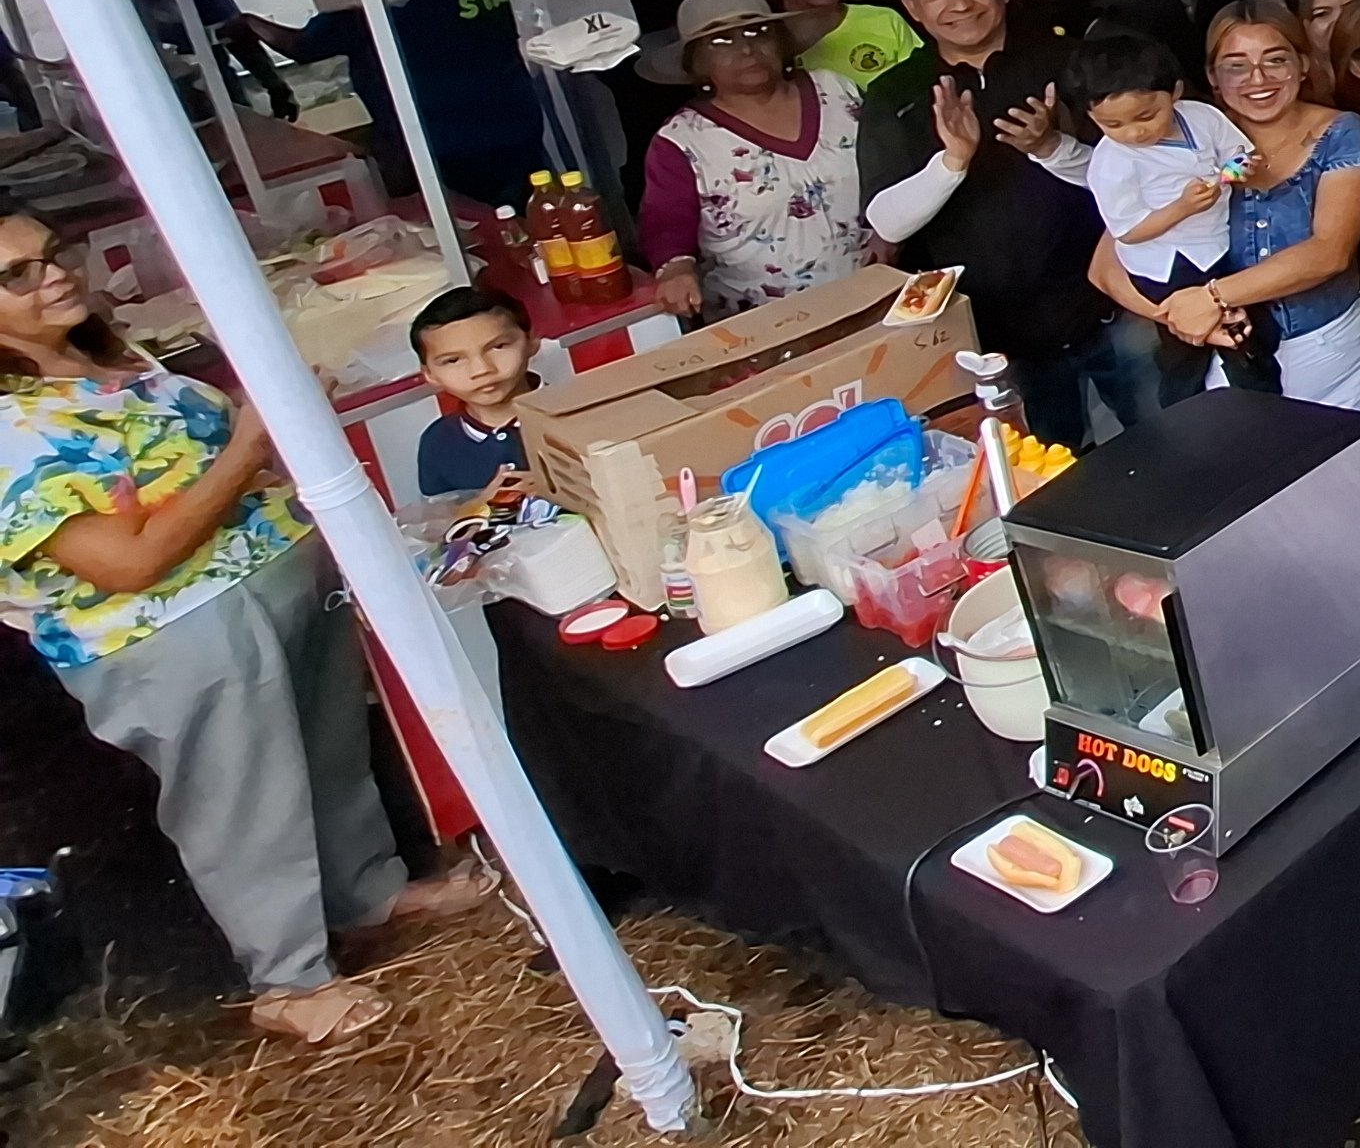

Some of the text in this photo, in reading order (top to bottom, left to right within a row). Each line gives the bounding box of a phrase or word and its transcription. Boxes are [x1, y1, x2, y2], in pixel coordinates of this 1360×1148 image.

[583, 13, 612, 34] XL
[1078, 733, 1118, 761] HOT
[1122, 748, 1177, 783] DOGS
